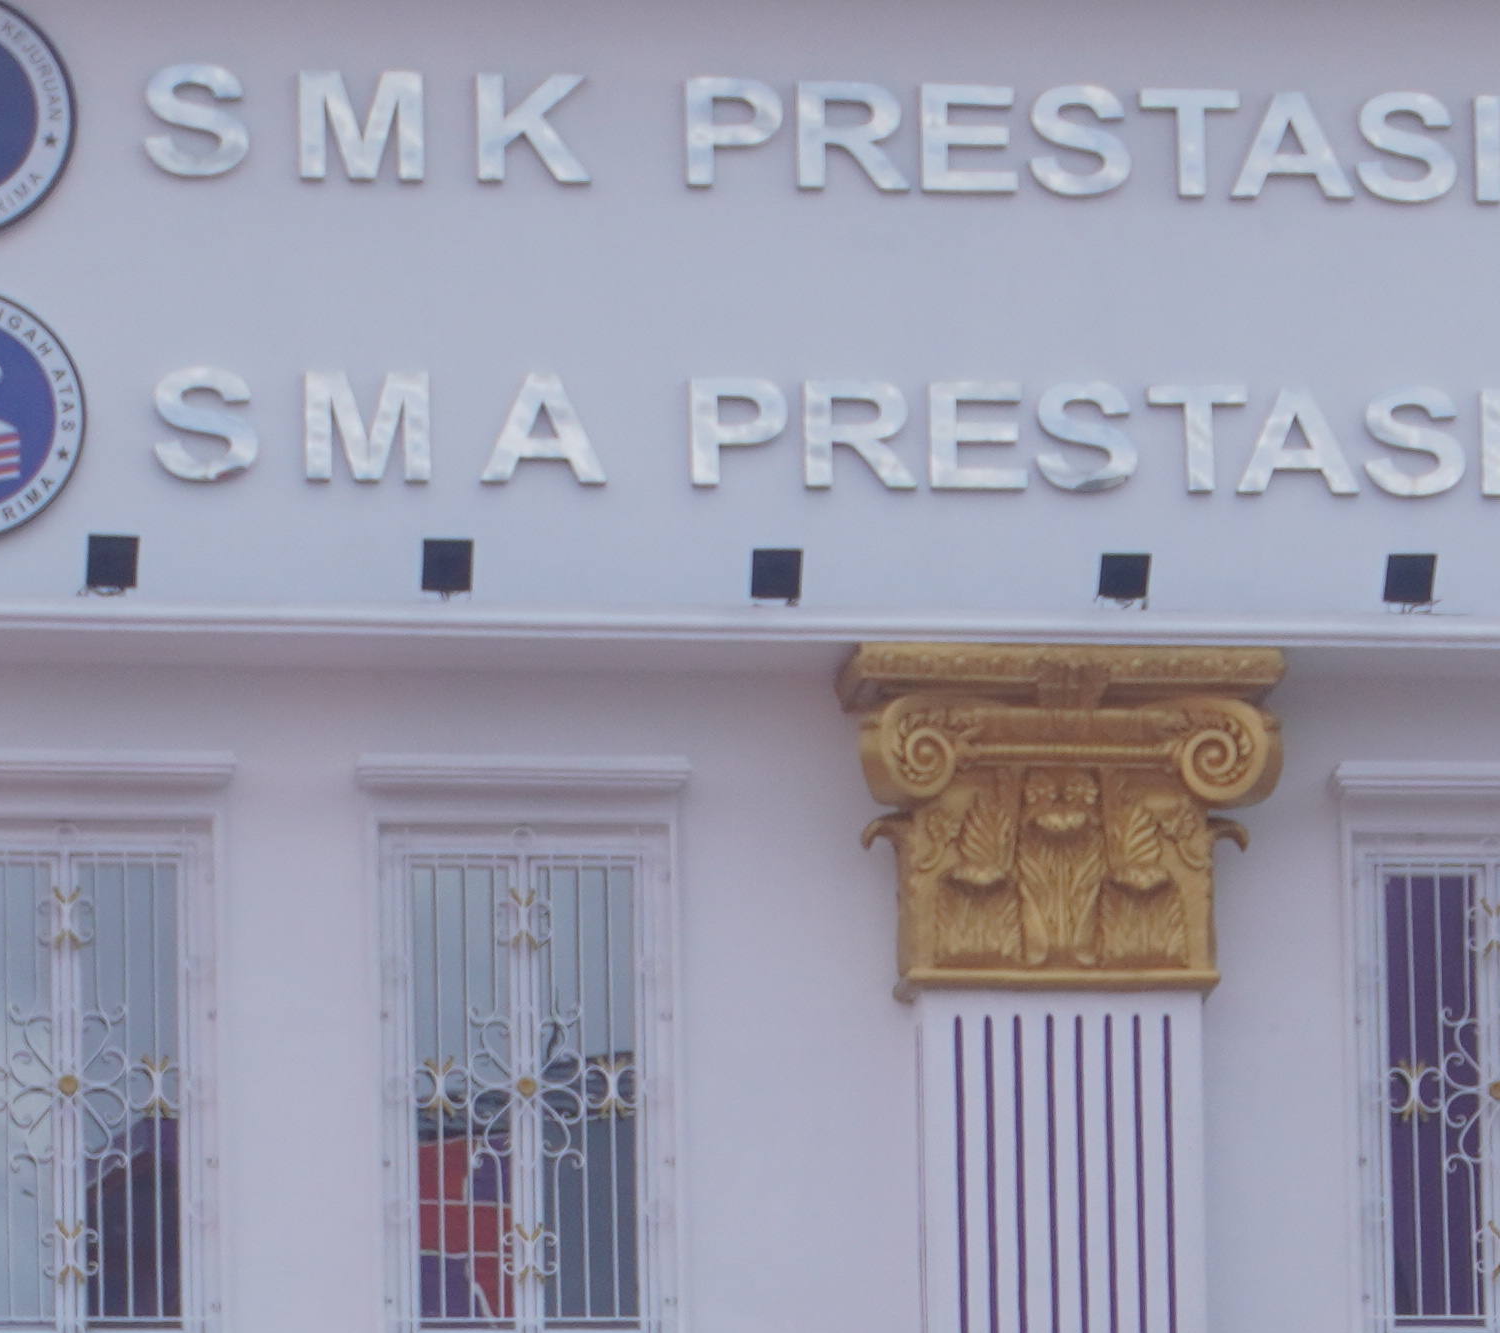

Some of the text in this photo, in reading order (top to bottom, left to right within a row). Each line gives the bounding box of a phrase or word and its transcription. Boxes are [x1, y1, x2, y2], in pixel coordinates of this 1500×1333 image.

[1, 22, 65, 121] KEJURUAN
[143, 62, 592, 185] SMK
[51, 368, 76, 432] ATAS
[152, 366, 607, 488] SMA
